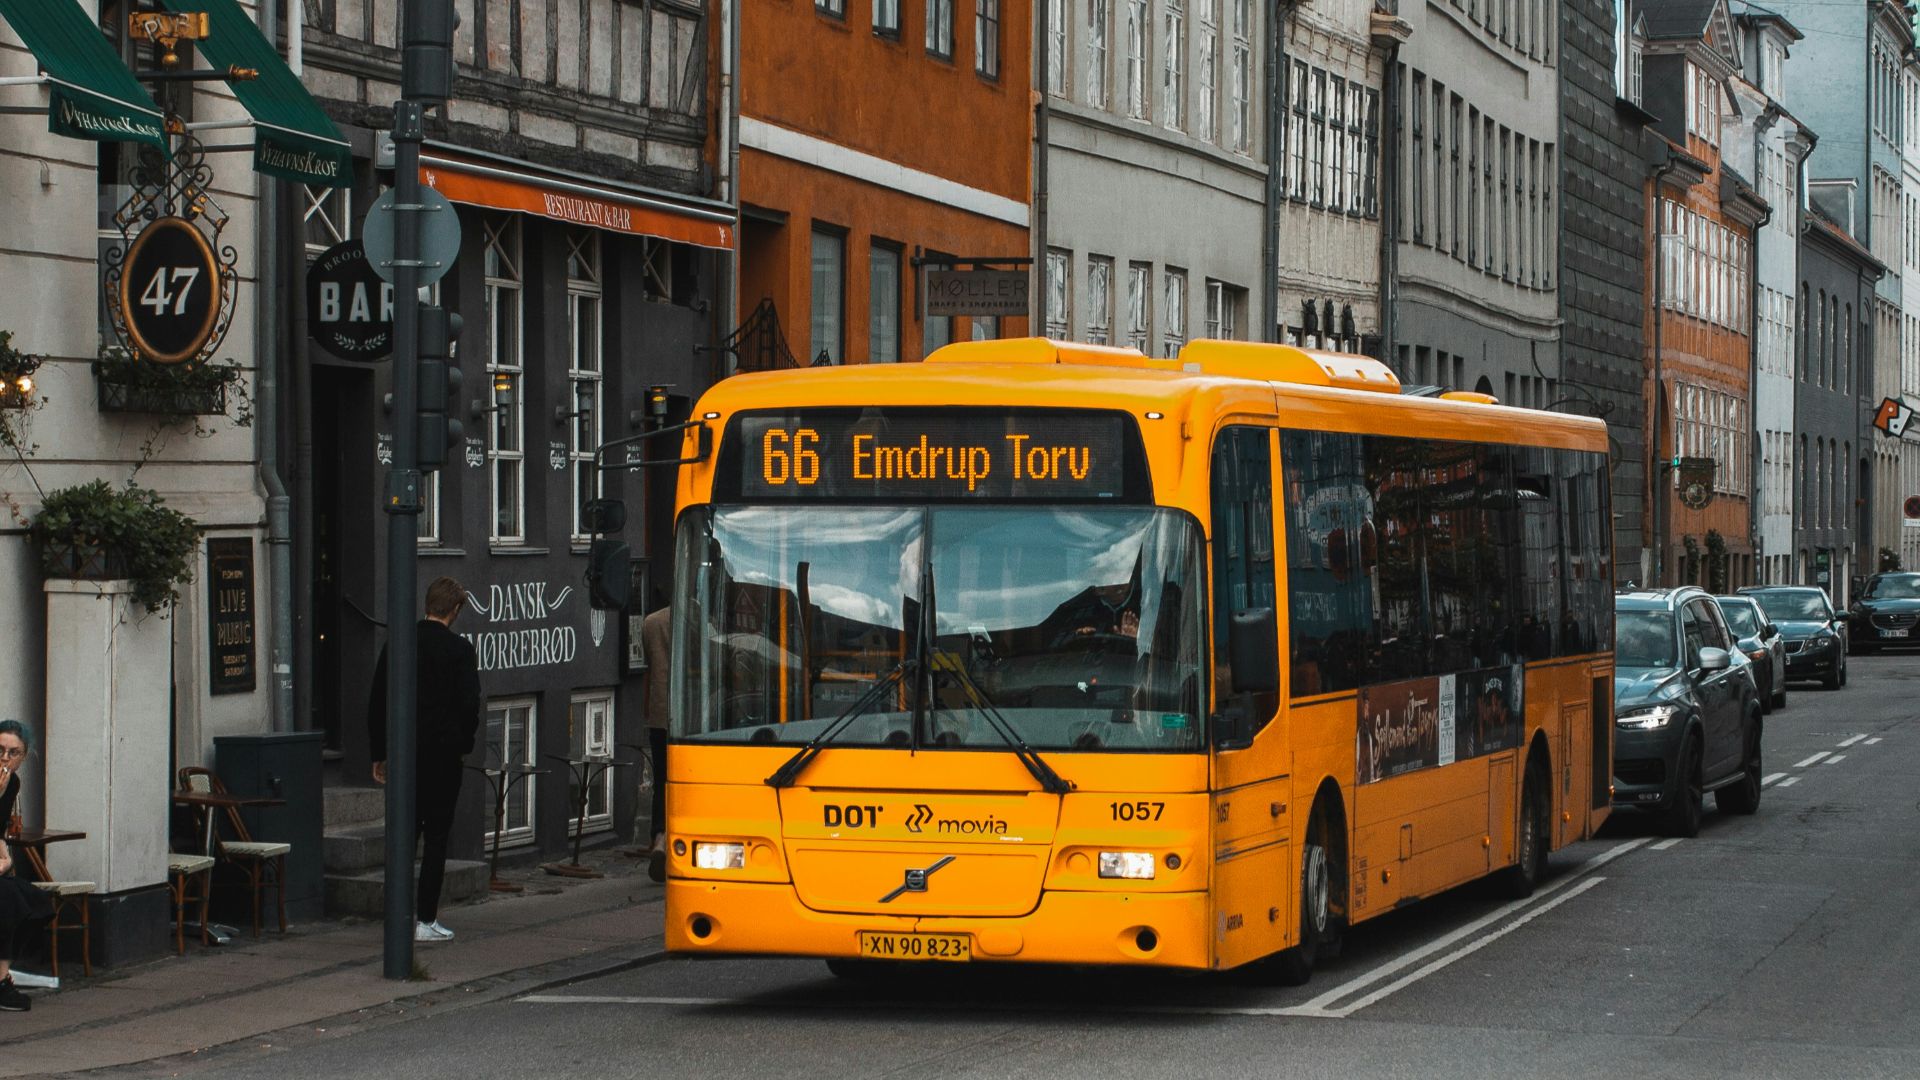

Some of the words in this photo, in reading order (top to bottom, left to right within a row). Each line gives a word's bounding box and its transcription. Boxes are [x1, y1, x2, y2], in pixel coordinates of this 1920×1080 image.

[543, 193, 603, 224] RESTAURANT
[604, 205, 612, 226] &
[612, 206, 631, 230] BAR
[323, 249, 367, 271] BROO
[140, 266, 200, 316] 47
[928, 279, 1028, 297] MØLLER
[320, 281, 395, 322] BAR
[762, 428, 820, 486] 66
[852, 434, 991, 491] Emdrup
[1005, 434, 1090, 481] Torv
[220, 589, 247, 613] LIVE
[489, 581, 548, 622] DANSK
[217, 621, 252, 646] MUSIC
[460, 626, 576, 671] MØRREBRØD
[823, 804, 878, 828] DOT
[1110, 802, 1165, 821] 1057
[938, 814, 1008, 835] movia
[870, 936, 895, 955] XN
[900, 937, 922, 956] 90
[927, 938, 962, 957] 823
